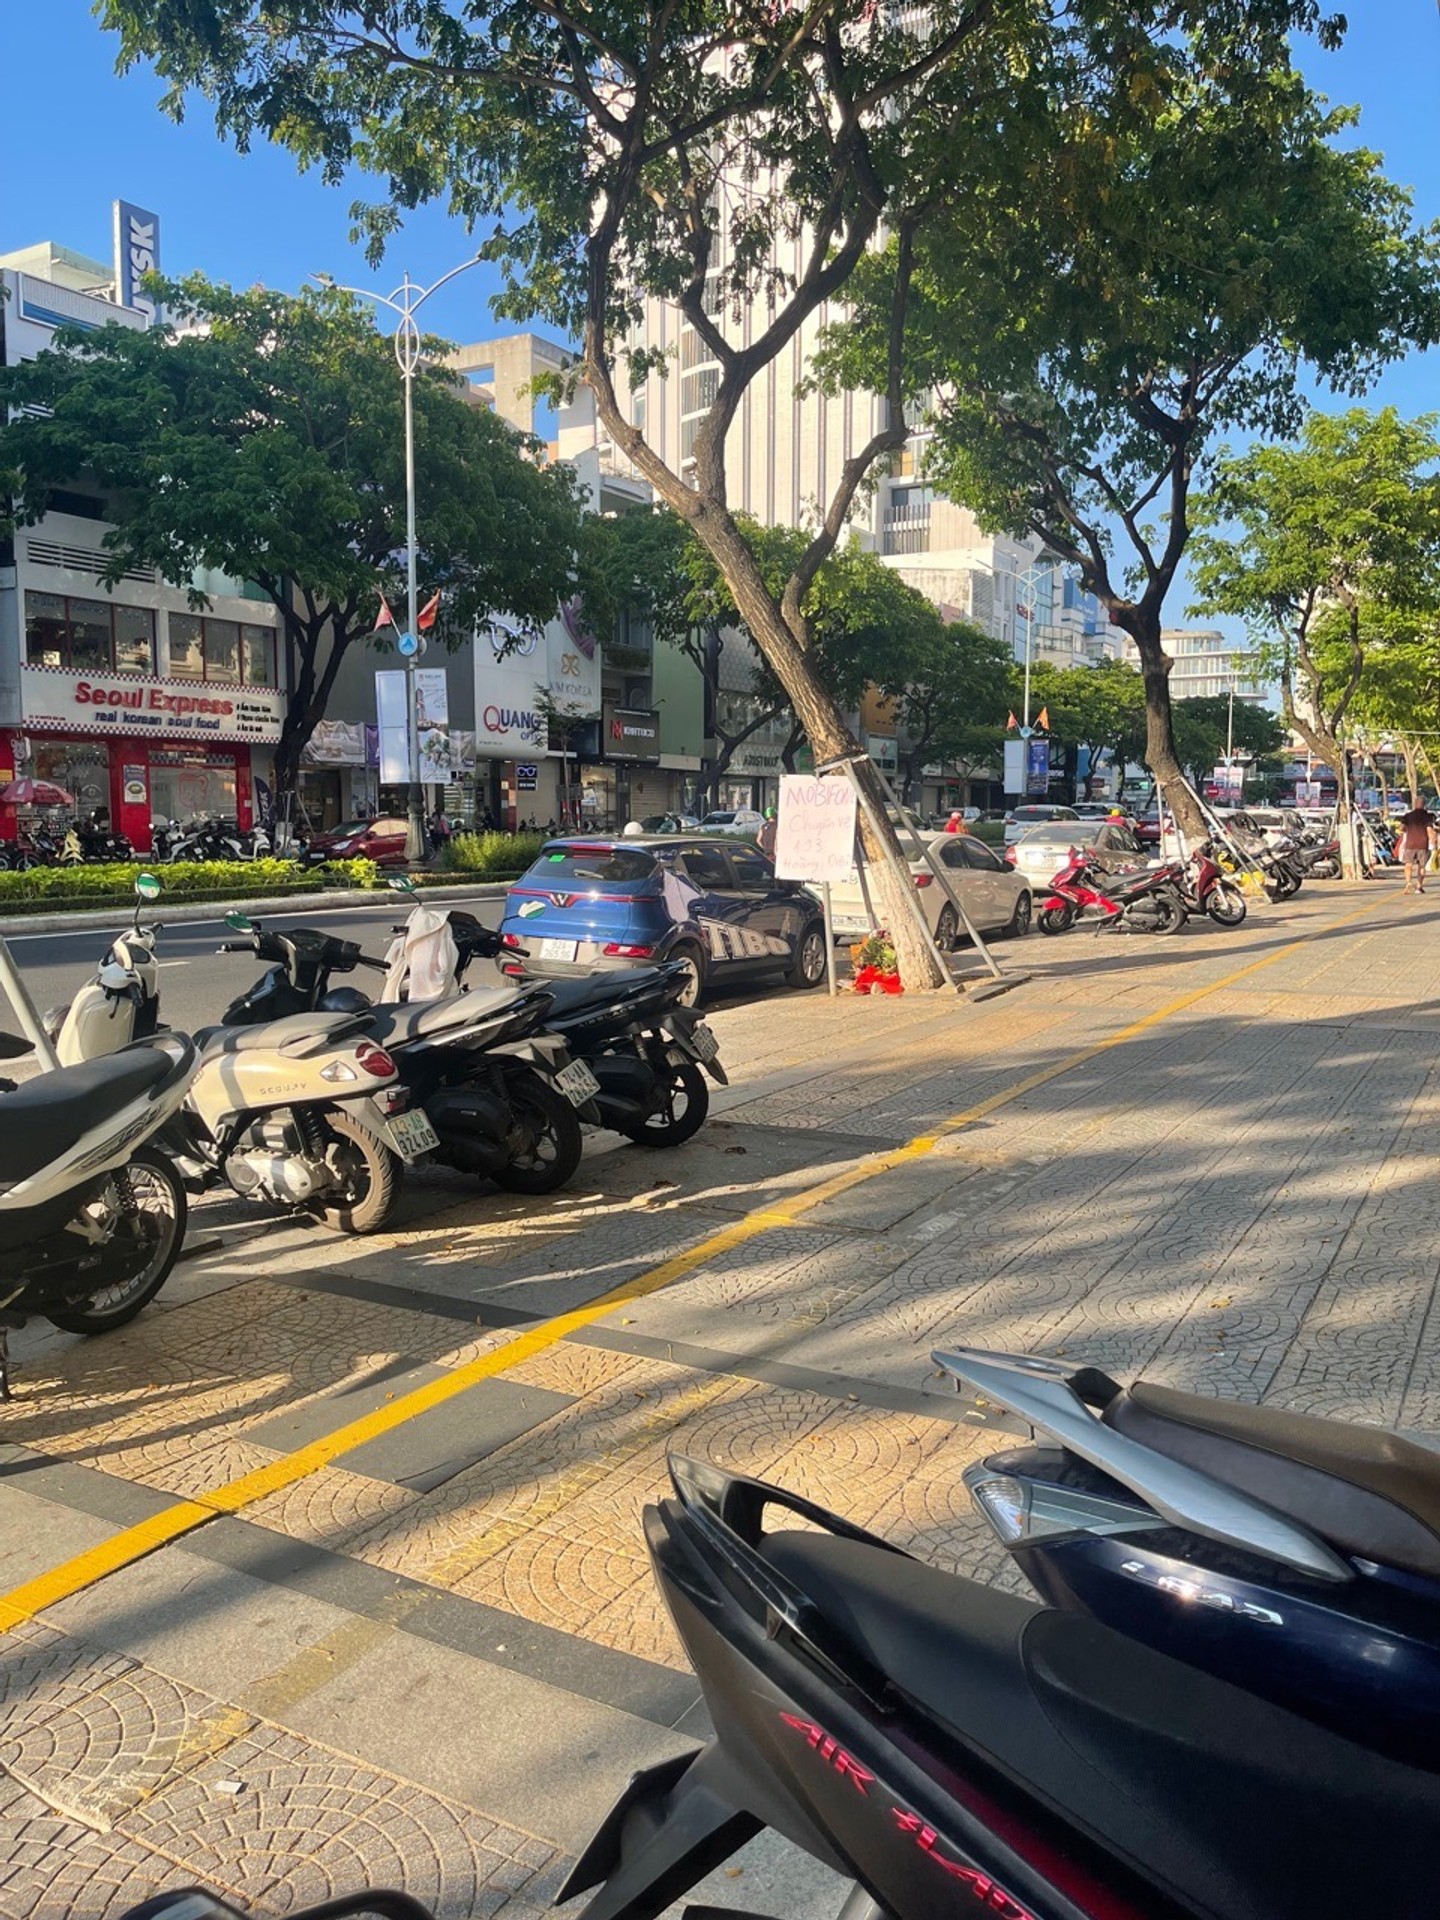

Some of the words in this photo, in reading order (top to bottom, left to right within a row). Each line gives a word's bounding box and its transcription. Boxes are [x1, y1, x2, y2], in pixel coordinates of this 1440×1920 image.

[75, 682, 143, 708] Seoul
[148, 689, 233, 716] Express
[95, 711, 117, 723] real
[123, 712, 161, 726] korean
[168, 717, 193, 729] soul
[196, 717, 220, 730] food
[483, 705, 541, 734] QUANG
[779, 1711, 875, 1797] AIR
